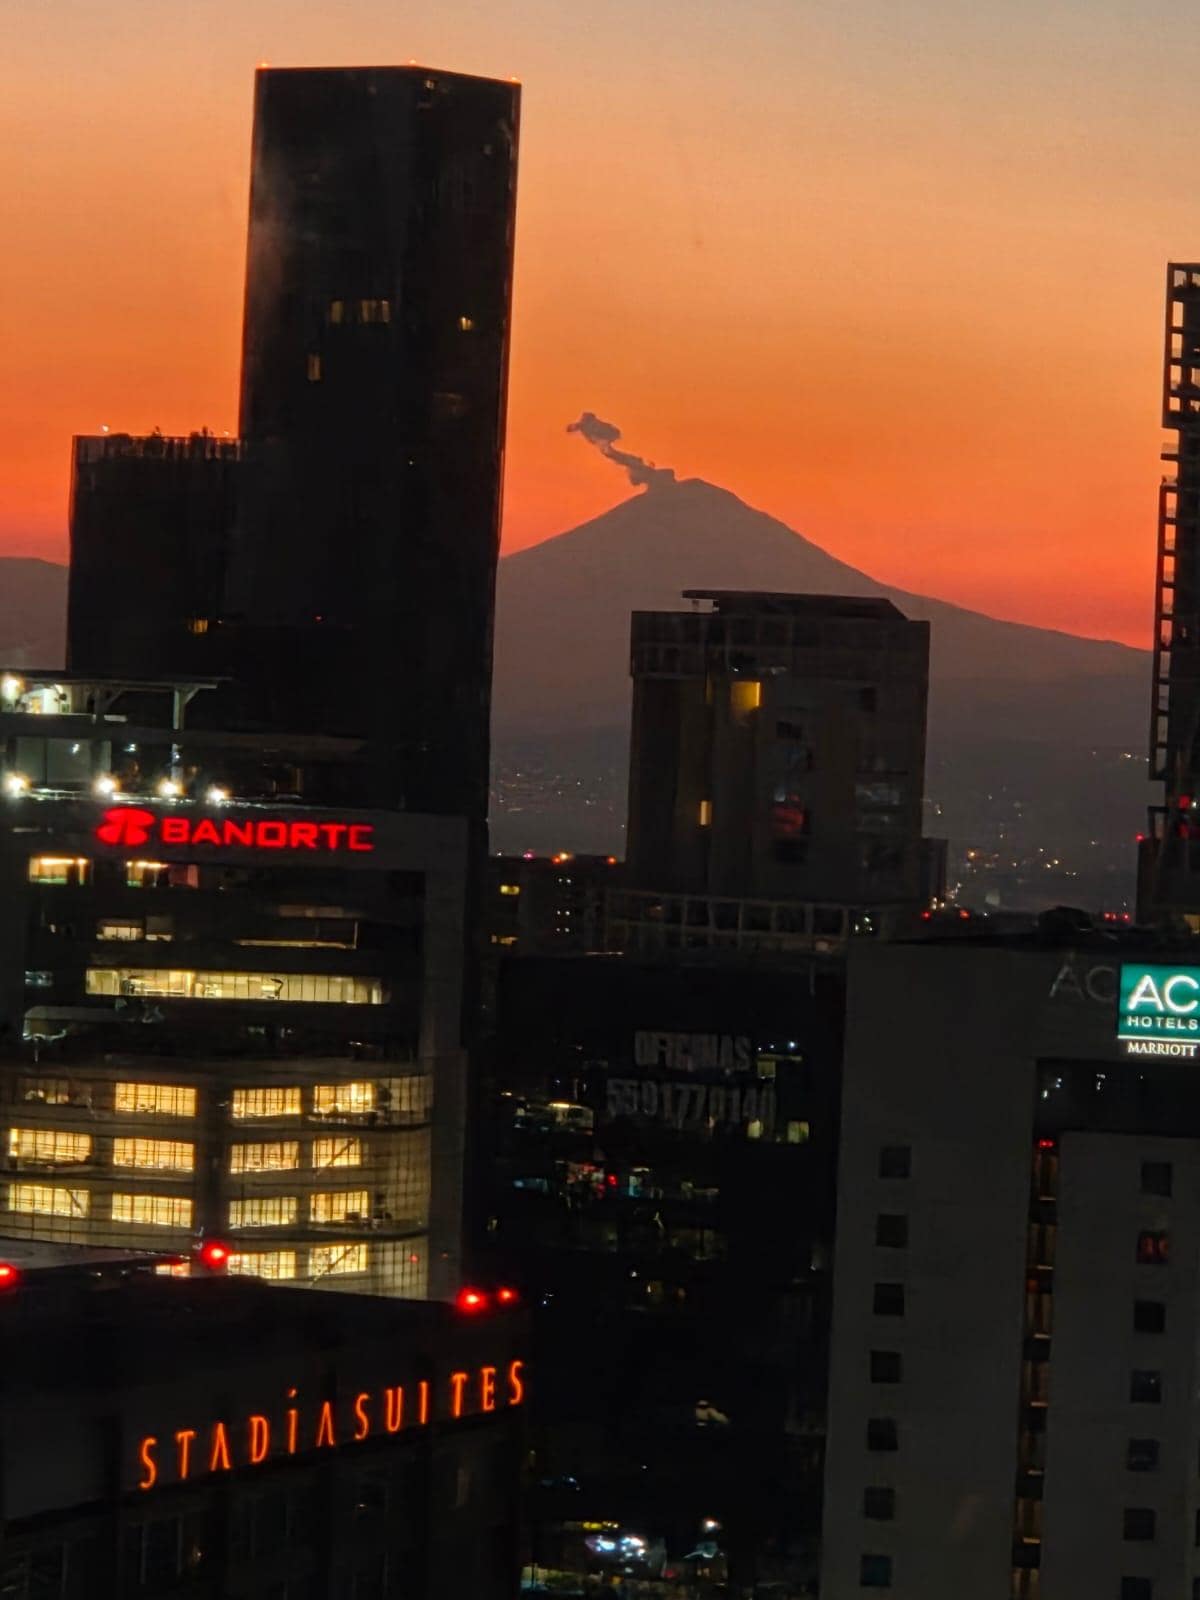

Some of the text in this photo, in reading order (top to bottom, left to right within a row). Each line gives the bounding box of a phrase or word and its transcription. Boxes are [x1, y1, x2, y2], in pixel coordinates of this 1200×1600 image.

[1049, 961, 1117, 1004] AC
[1127, 975, 1199, 1013] AC
[1127, 1016, 1199, 1030] HOTELS
[1127, 1041, 1198, 1056] MARRIOTT
